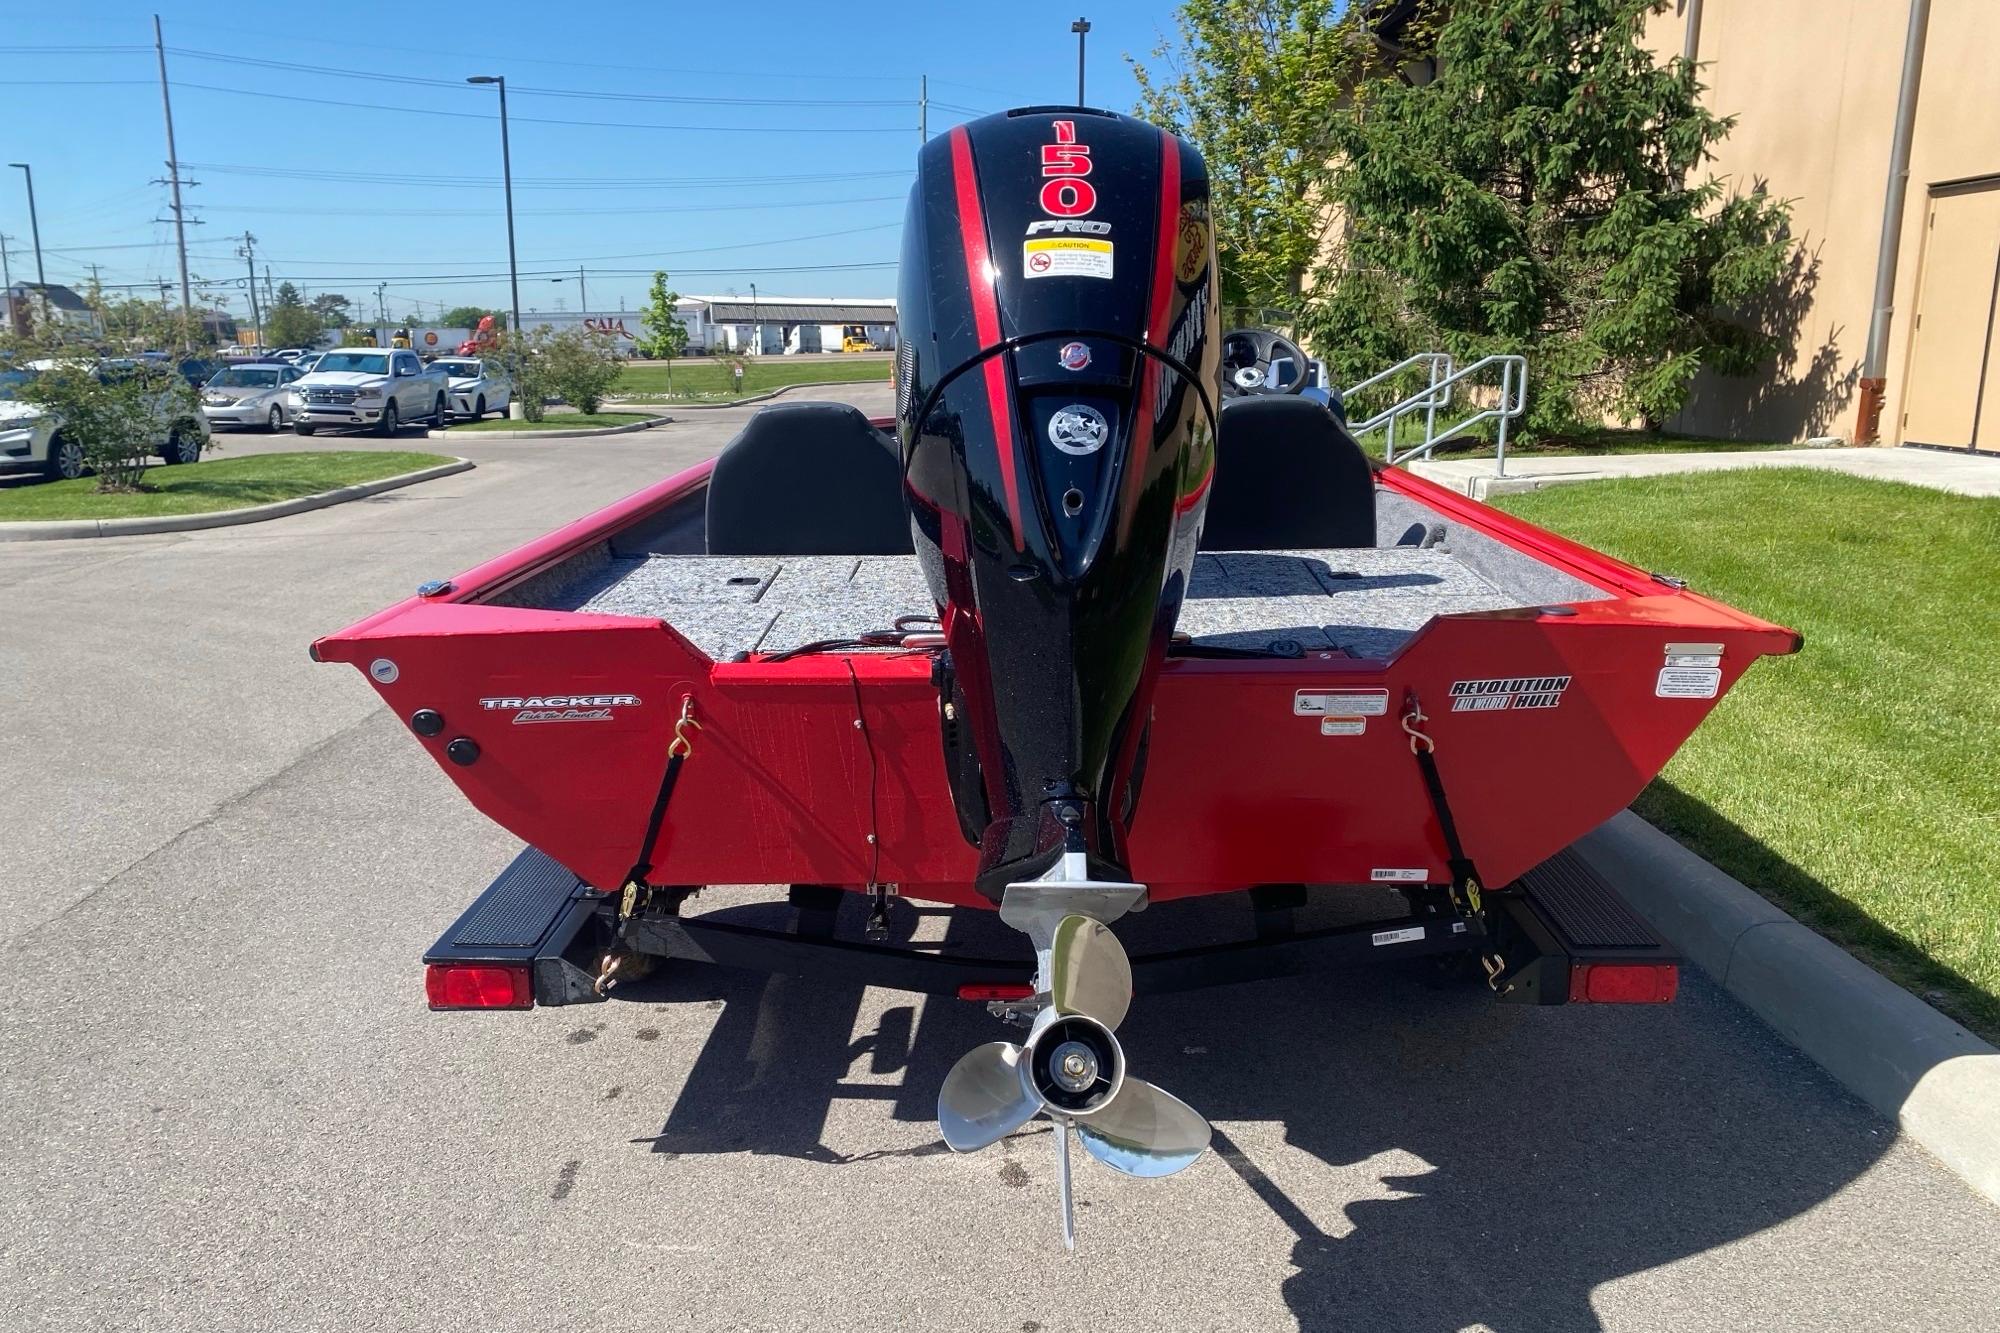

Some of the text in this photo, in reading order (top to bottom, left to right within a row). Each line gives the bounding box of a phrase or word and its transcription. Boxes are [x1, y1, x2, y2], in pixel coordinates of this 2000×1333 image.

[1040, 121, 1097, 217] 150
[1025, 220, 1112, 235] PRO
[583, 317, 631, 336] SAIA
[1450, 677, 1570, 695] REVOLUTION
[480, 695, 635, 709] TRACKER
[1514, 693, 1560, 708] HULL
